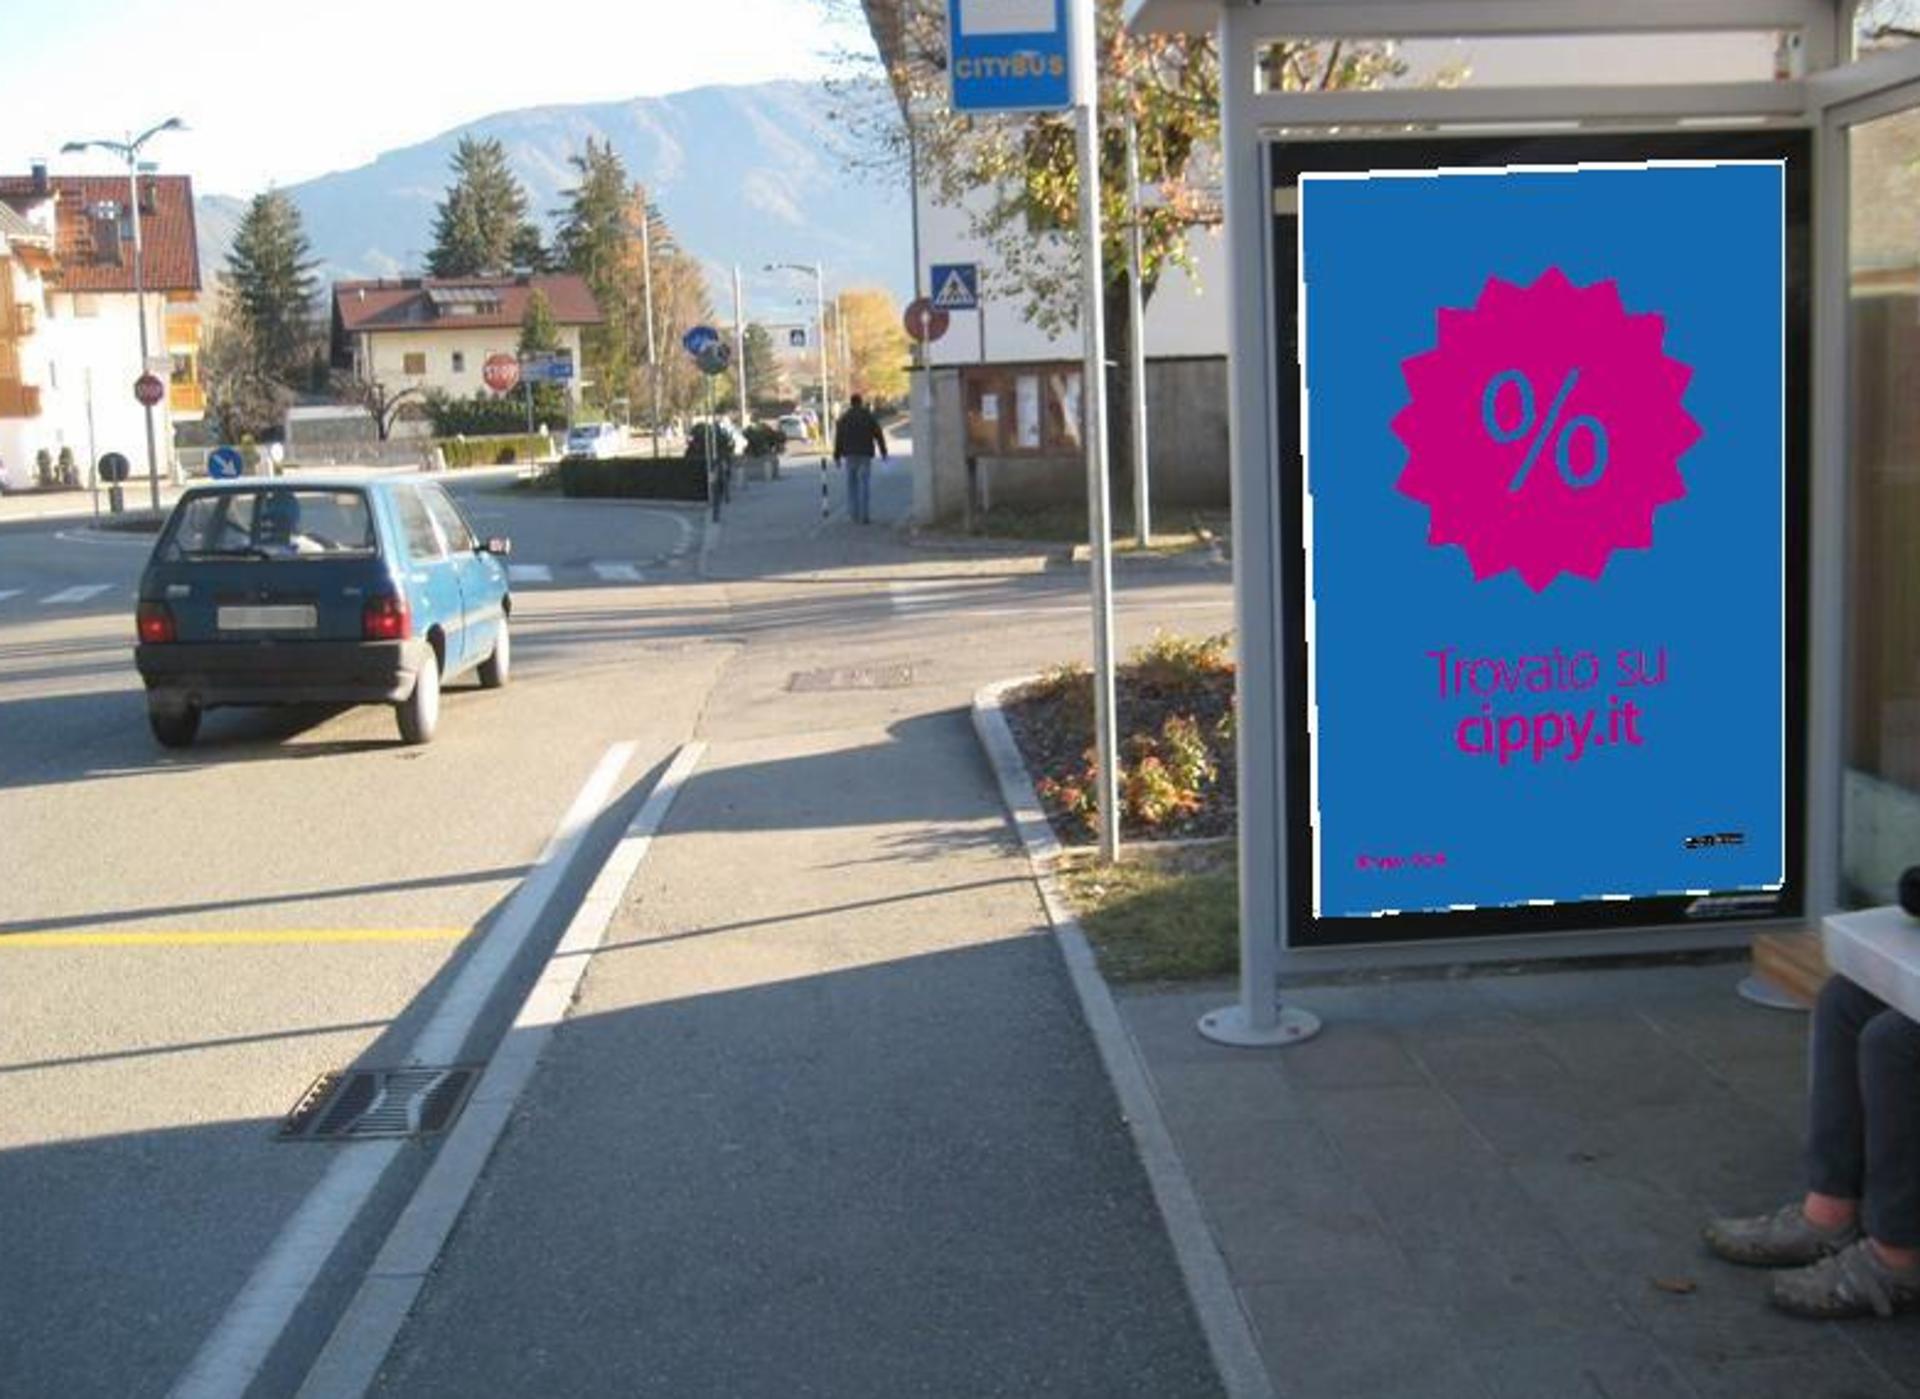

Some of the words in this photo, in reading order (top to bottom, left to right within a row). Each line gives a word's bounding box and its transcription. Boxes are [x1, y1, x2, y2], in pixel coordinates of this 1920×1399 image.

[956, 54, 1064, 78] CITYBUS
[1481, 367, 1608, 491] %
[1426, 647, 1599, 699] Trovato
[1616, 648, 1667, 688] su
[1457, 695, 1643, 766] cippy.it
